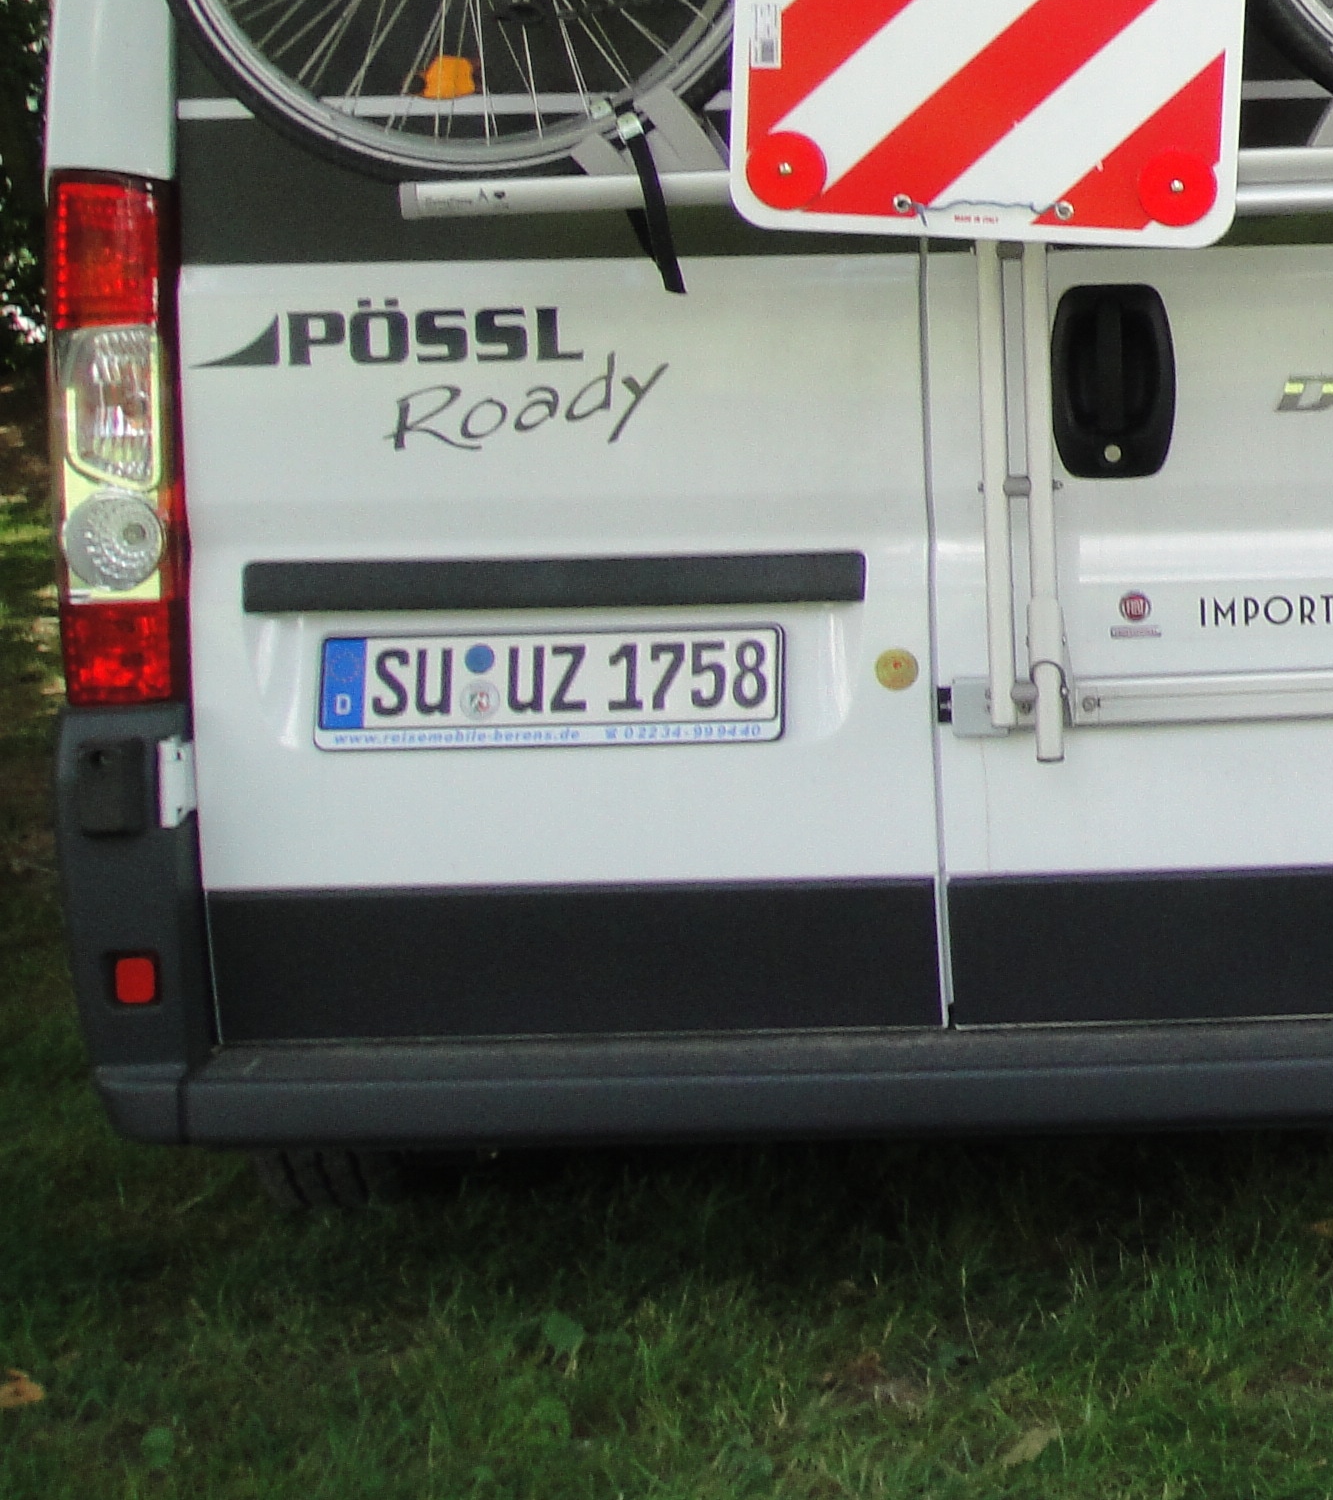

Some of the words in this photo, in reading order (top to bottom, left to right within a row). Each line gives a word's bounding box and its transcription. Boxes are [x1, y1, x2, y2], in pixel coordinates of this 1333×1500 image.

[286, 298, 584, 366] PÖSSL
[384, 351, 669, 451] Roady
[334, 693, 350, 715] D
[372, 646, 453, 717] SU
[507, 644, 588, 713] UZ
[608, 639, 768, 711] 1758
